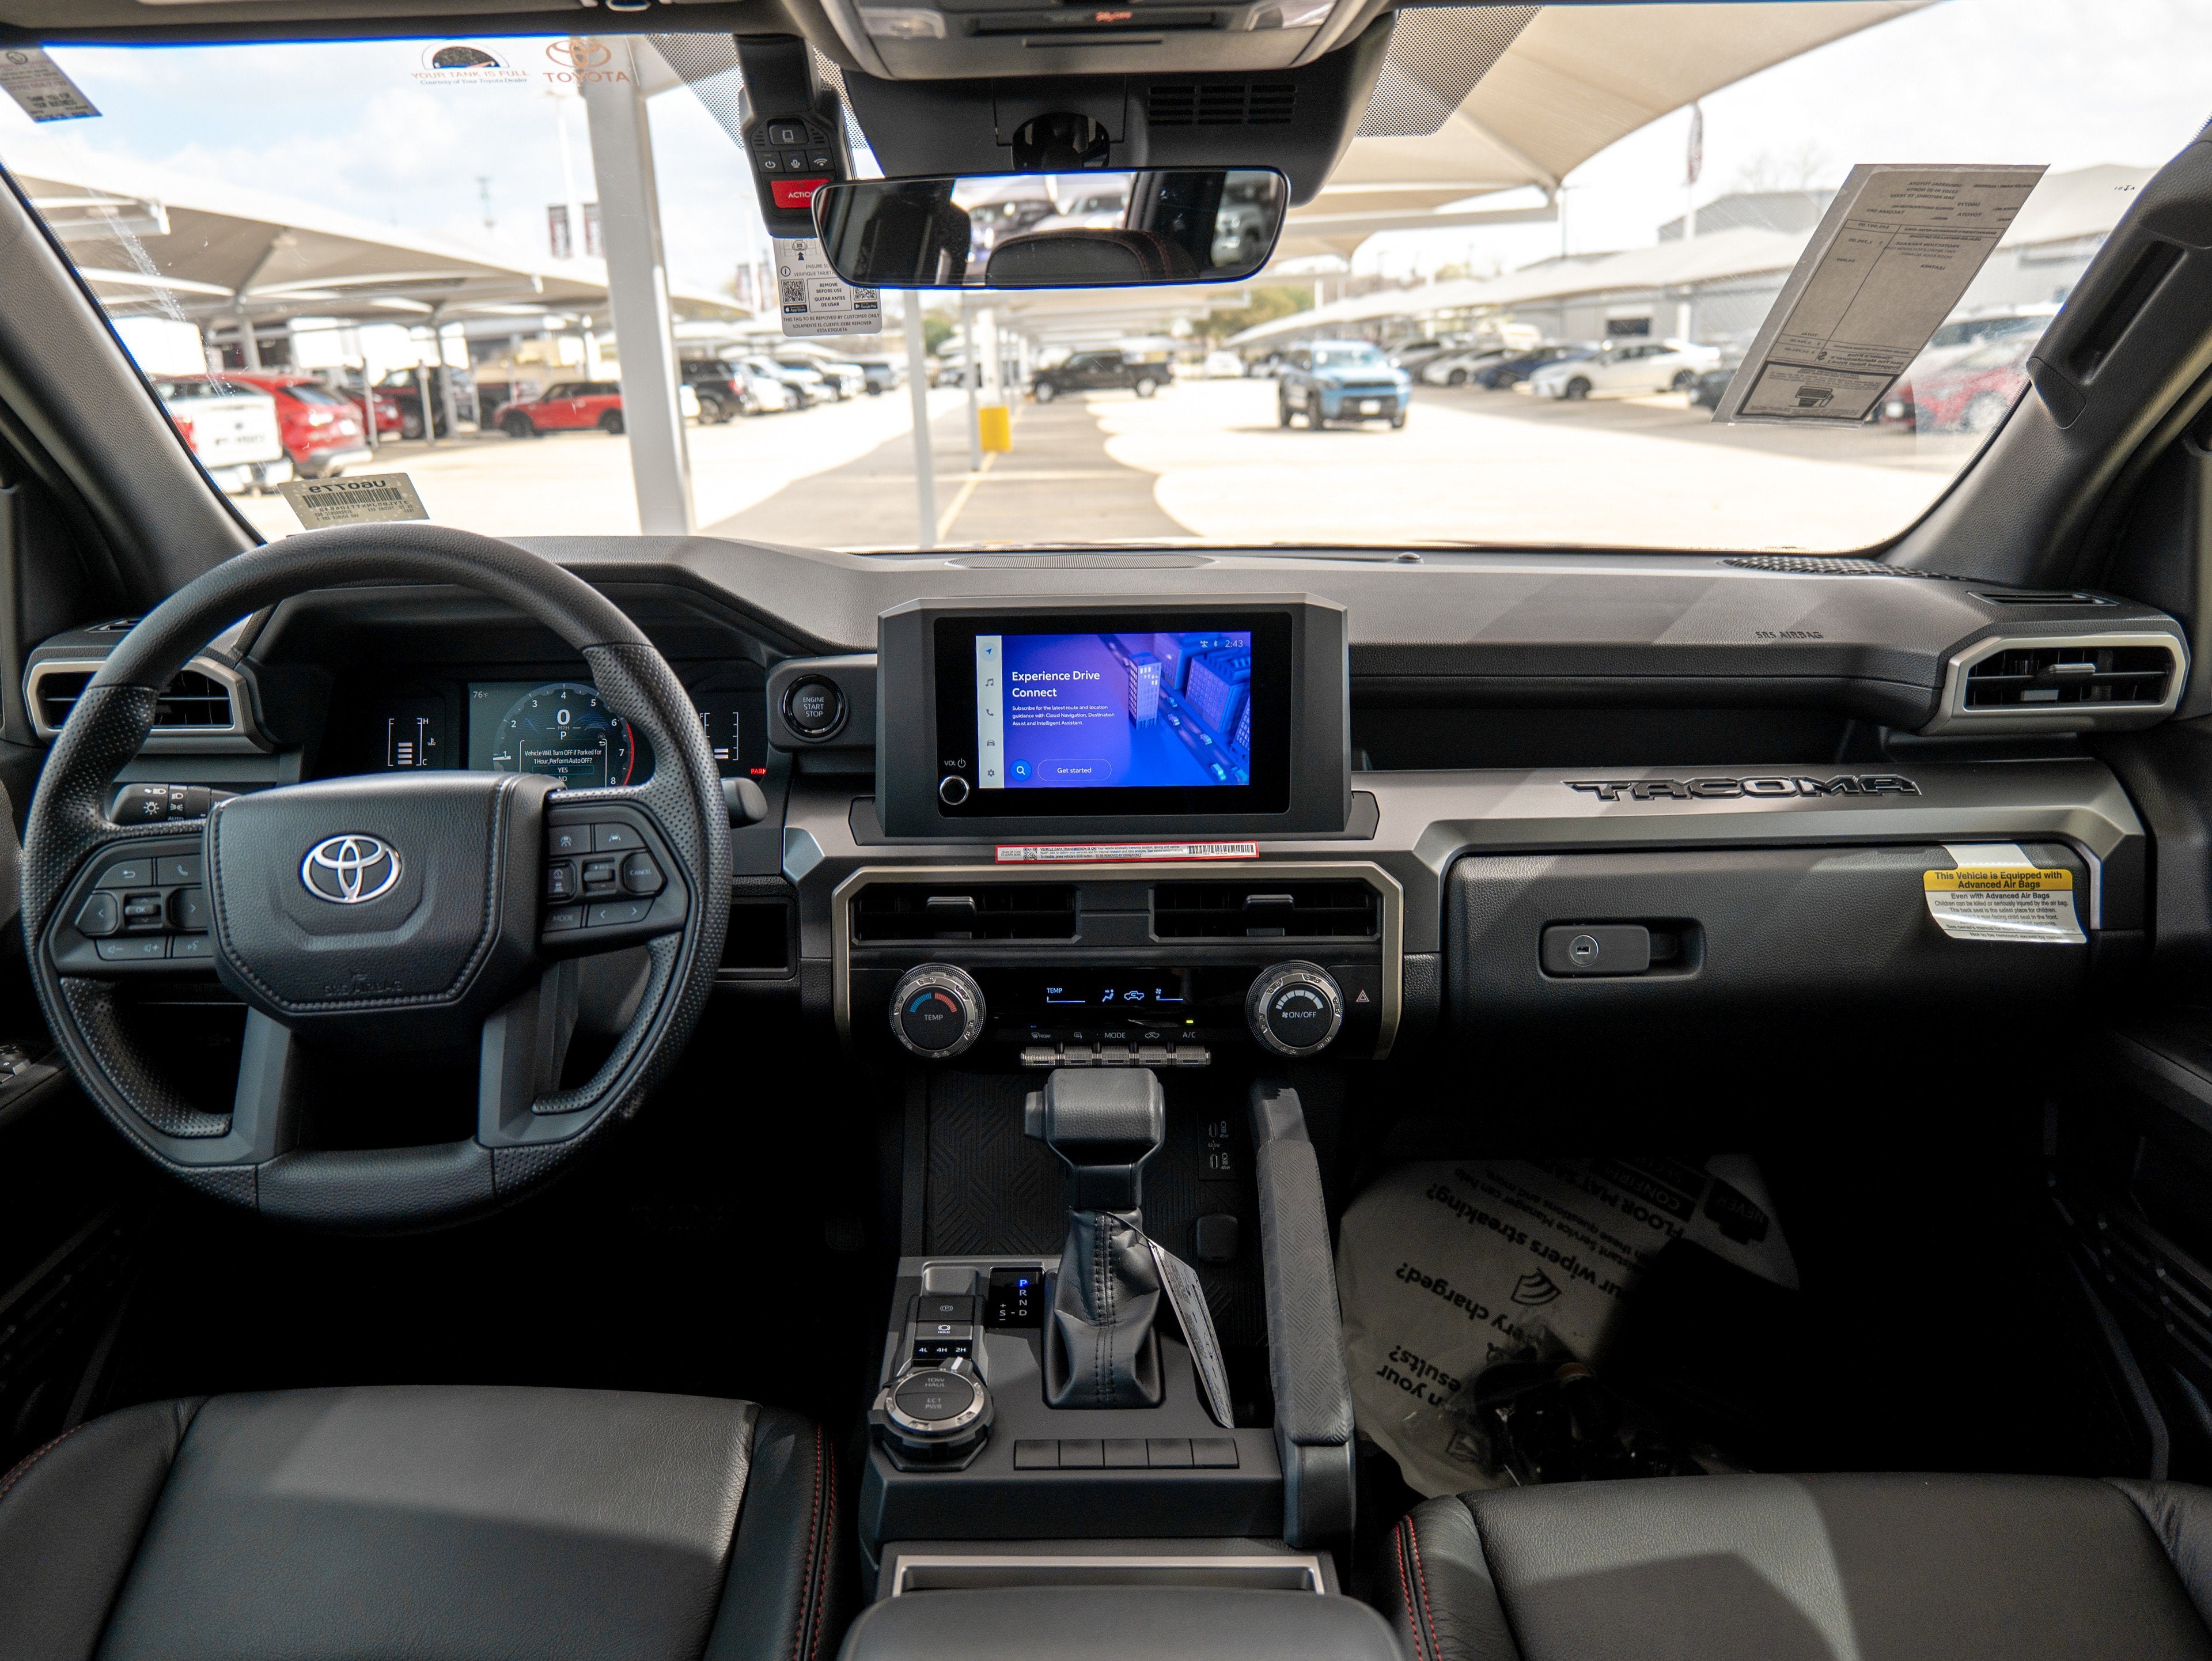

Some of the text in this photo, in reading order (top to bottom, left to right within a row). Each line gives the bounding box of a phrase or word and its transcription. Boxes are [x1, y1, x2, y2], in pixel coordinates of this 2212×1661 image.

[543, 71, 630, 84] TOYOTA
[1225, 640, 1243, 648] 2:43
[1012, 670, 1100, 683] Experience Drive
[1012, 687, 1058, 698] Connect
[556, 709, 571, 725] 0
[611, 718, 618, 727] 6
[511, 720, 517, 728] 2
[560, 731, 567, 740] P
[503, 750, 507, 758] 1
[1560, 774, 1922, 801] TACOMA
[1935, 872, 1954, 880] This
[1956, 872, 1988, 880] Vehicle
[2001, 872, 2041, 881] Equipped
[2044, 871, 2062, 879] with
[1959, 880, 2001, 888] Advanced
[2018, 881, 2040, 890] Bags
[1426, 1183, 1597, 1287] wipers streaking?
[1396, 1262, 1489, 1323] charged?
[1376, 1363, 1427, 1399] your
